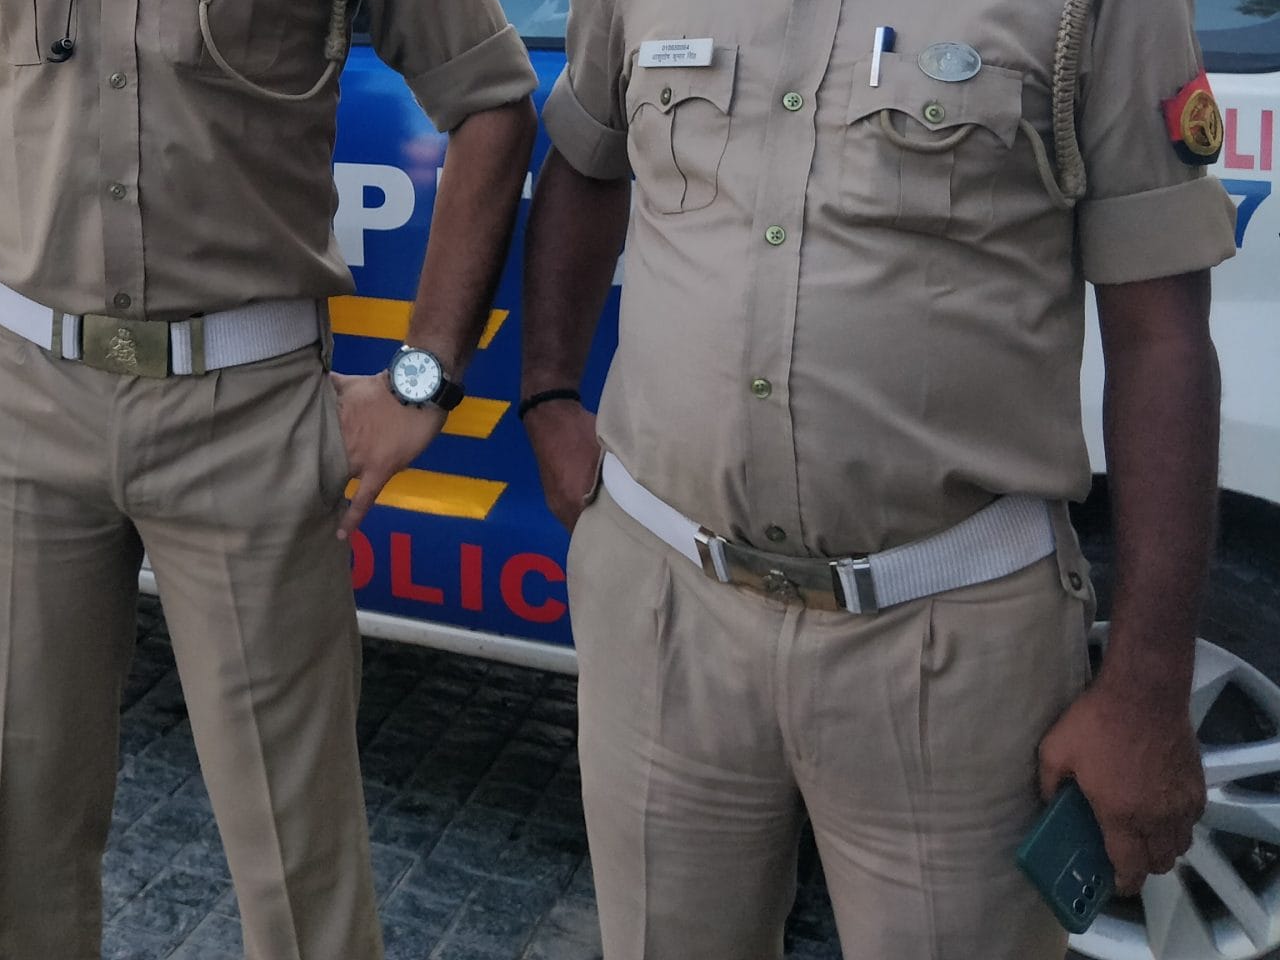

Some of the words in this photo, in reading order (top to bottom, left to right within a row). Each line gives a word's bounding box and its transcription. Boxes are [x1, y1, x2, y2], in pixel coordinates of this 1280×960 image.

[1224, 108, 1273, 171] LI
[333, 162, 416, 267] P
[351, 528, 567, 624] LIC
